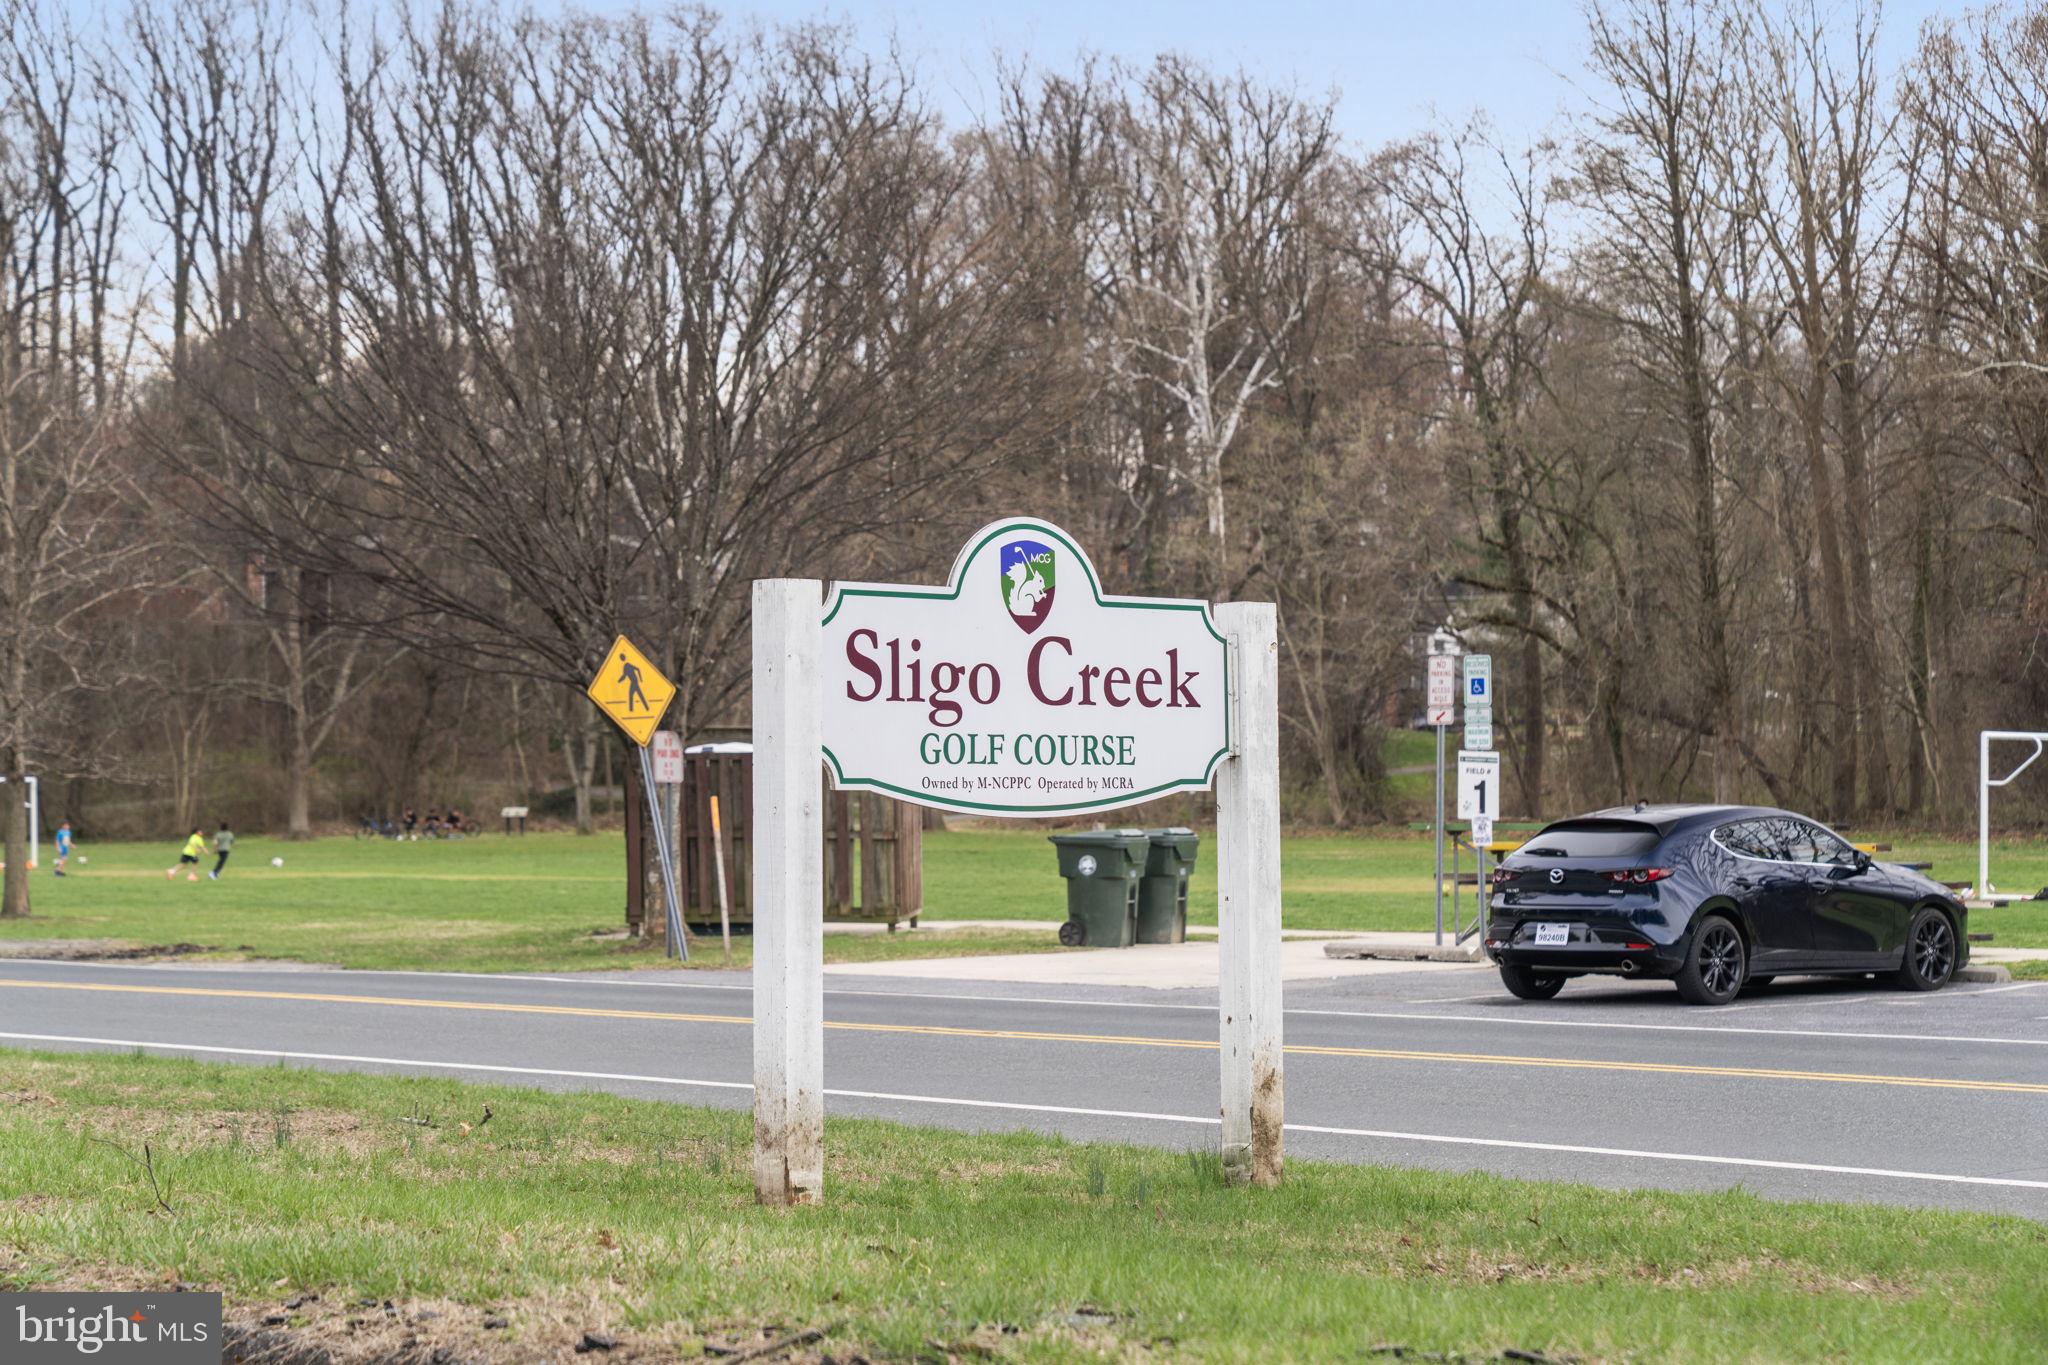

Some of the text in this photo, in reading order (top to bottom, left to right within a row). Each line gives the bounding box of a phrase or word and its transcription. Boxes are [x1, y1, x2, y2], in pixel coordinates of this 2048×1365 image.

[1030, 552, 1051, 564] MCG
[845, 628, 1201, 727] Sligo Creek
[920, 732, 1136, 766] GOLF COURSE
[921, 776, 1134, 793] Owned by M-NCPPC Operated by MCRA
[1474, 780, 1486, 814] 1
